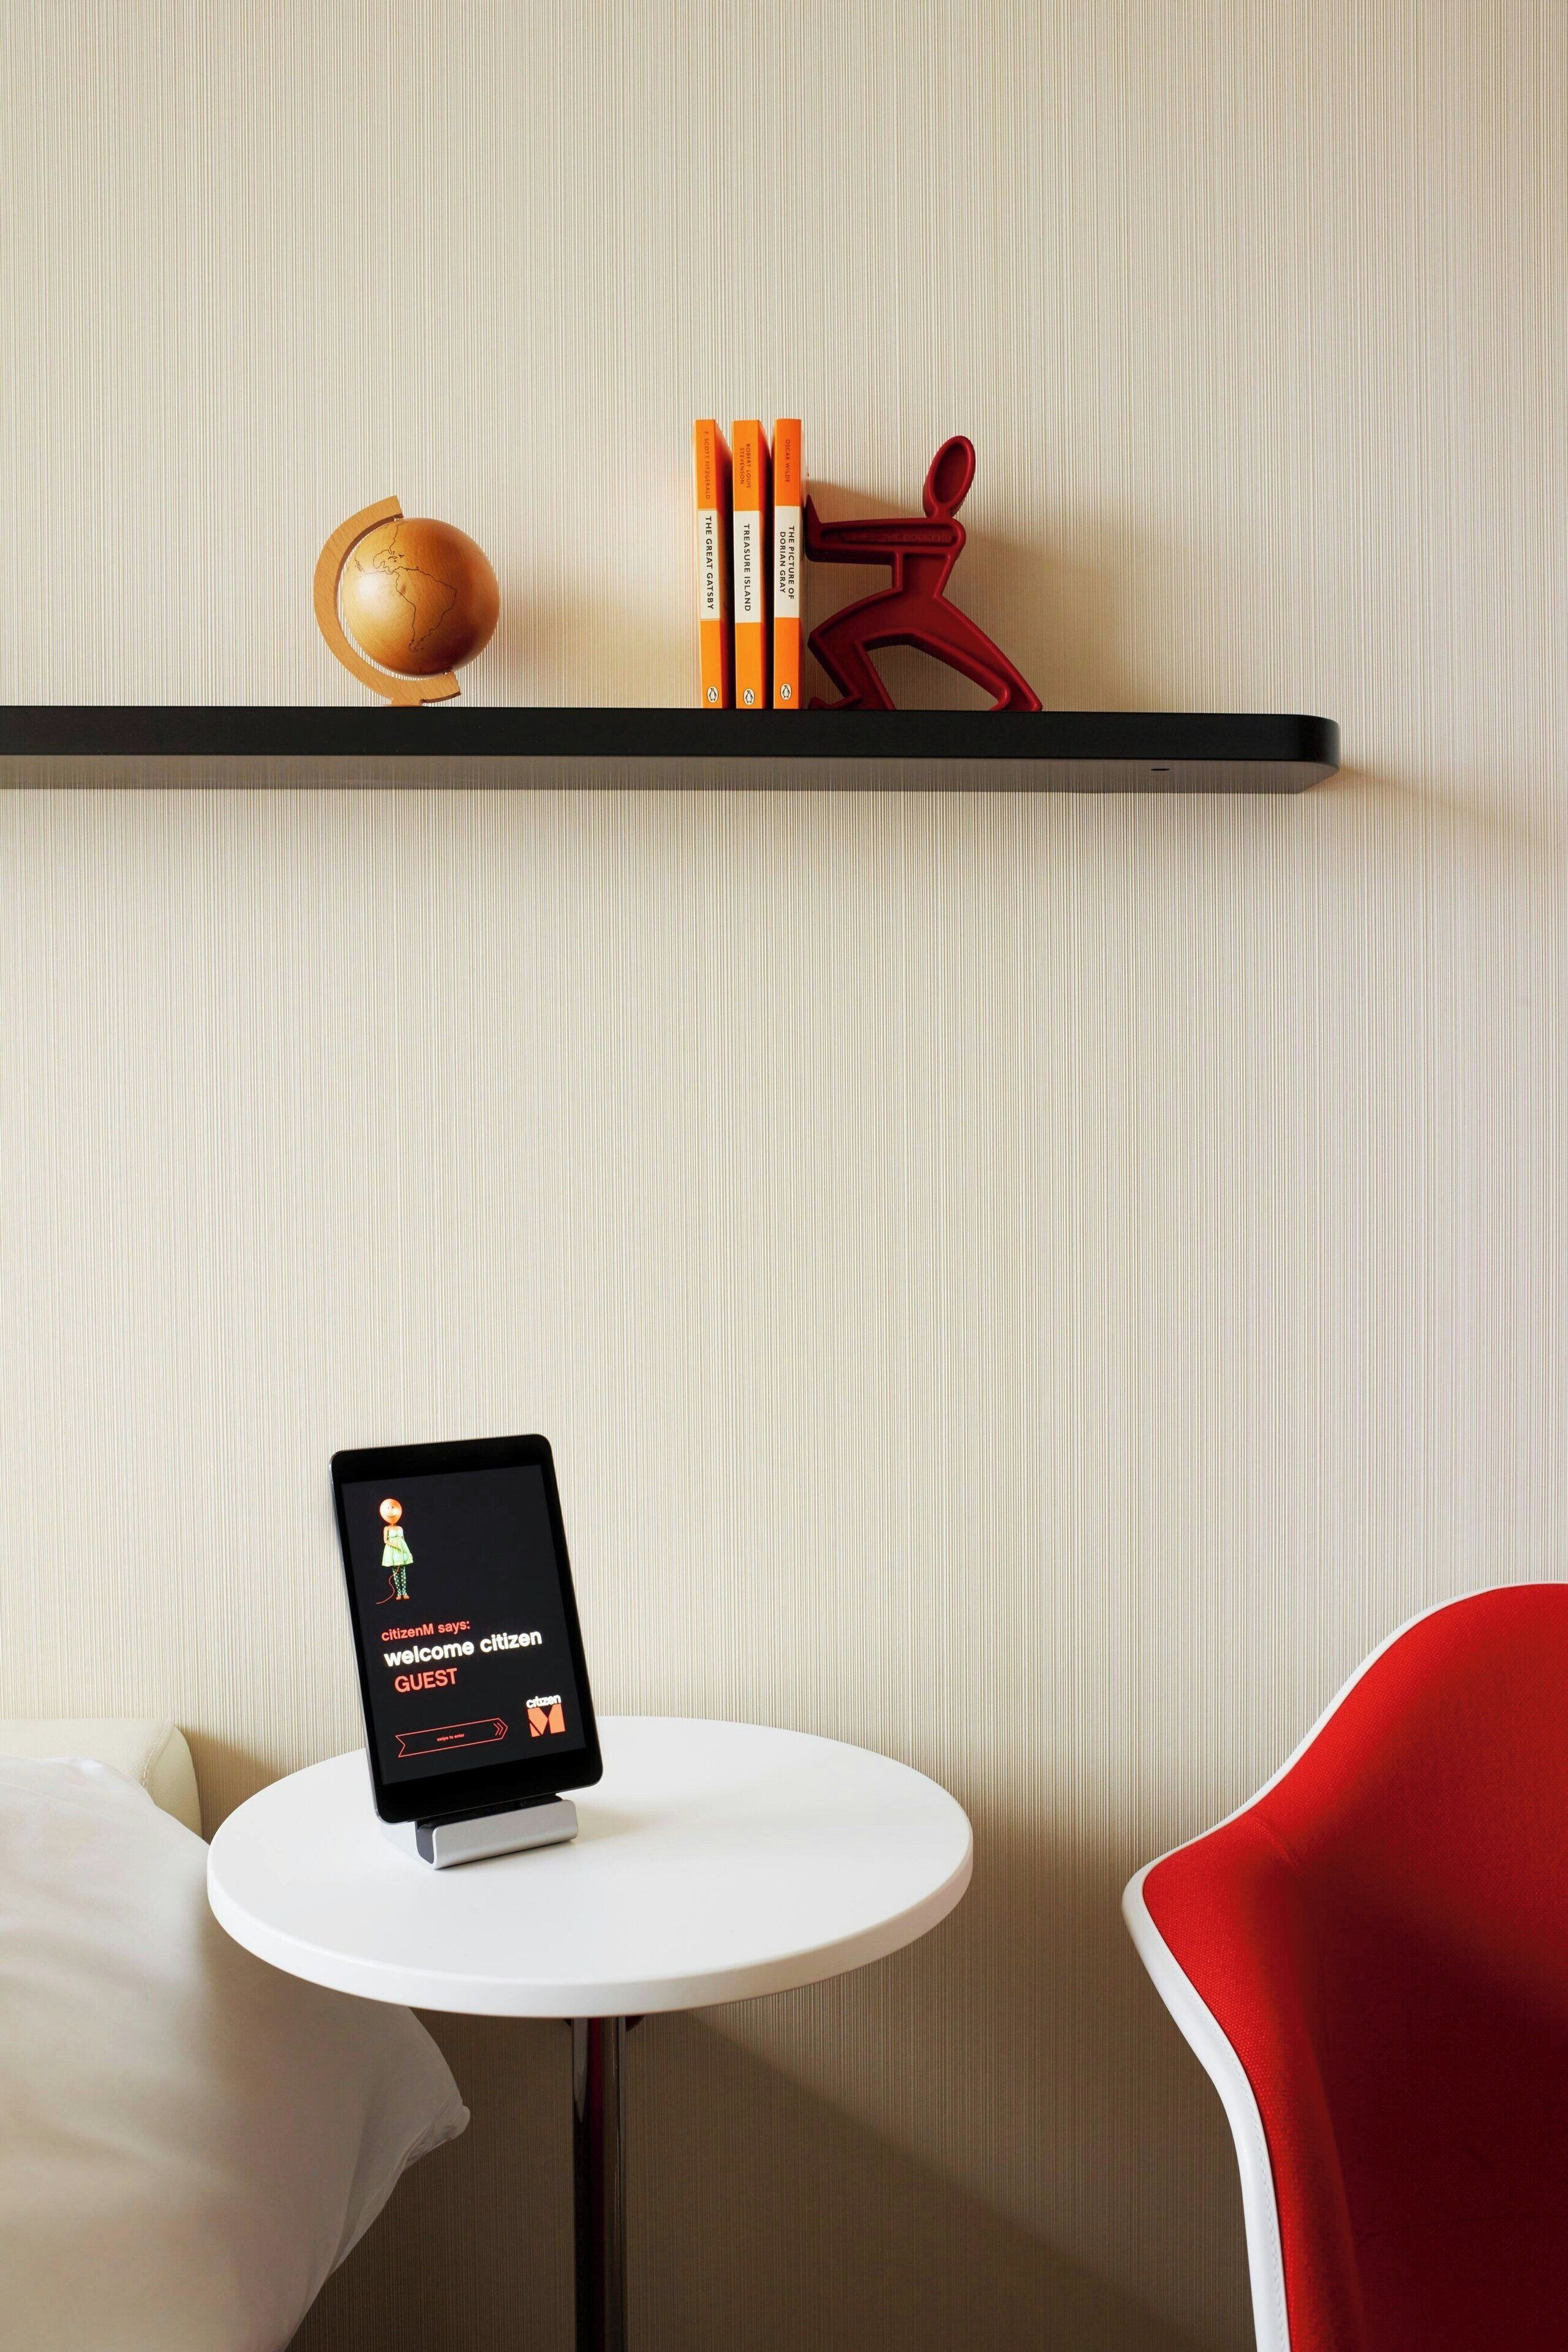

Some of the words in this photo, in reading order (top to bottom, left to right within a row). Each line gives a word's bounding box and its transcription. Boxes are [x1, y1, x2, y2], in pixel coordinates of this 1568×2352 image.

[788, 587, 794, 600] OF
[382, 1623, 434, 1641] citizenM
[437, 1621, 470, 1635] says:
[383, 1640, 475, 1667] welcome
[480, 1630, 543, 1653] citizen
[394, 1667, 458, 1693] GUEST
[526, 1694, 562, 1709] citizen
[527, 1703, 566, 1738] M
